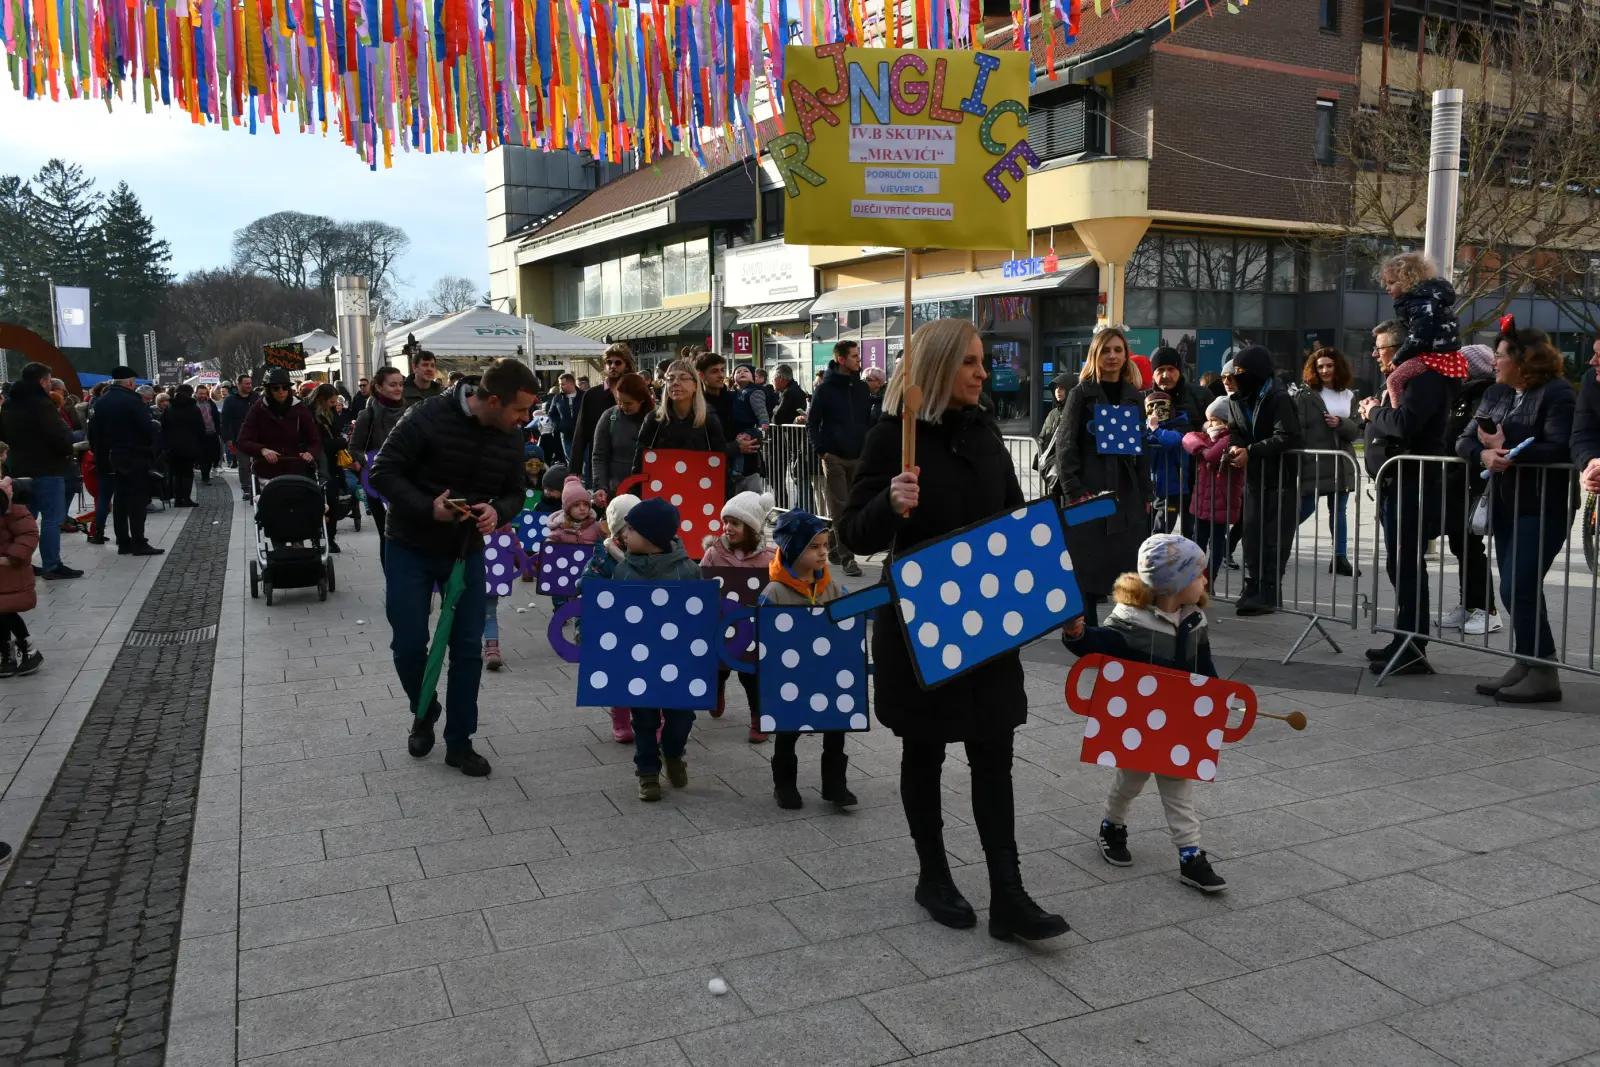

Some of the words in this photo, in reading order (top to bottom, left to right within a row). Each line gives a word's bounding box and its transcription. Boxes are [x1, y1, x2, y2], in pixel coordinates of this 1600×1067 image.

[852, 127, 882, 139] IV.B
[886, 128, 953, 141] SKUPINA
[866, 169, 911, 179] PODRUČNI
[913, 171, 938, 179] ODJEL
[880, 185, 924, 193] VJEVERICA
[853, 203, 881, 213] DJEČJI
[884, 205, 910, 215] VRTIĆ
[912, 208, 952, 217] CIPELICA
[1003, 256, 1043, 278] ERSTE
